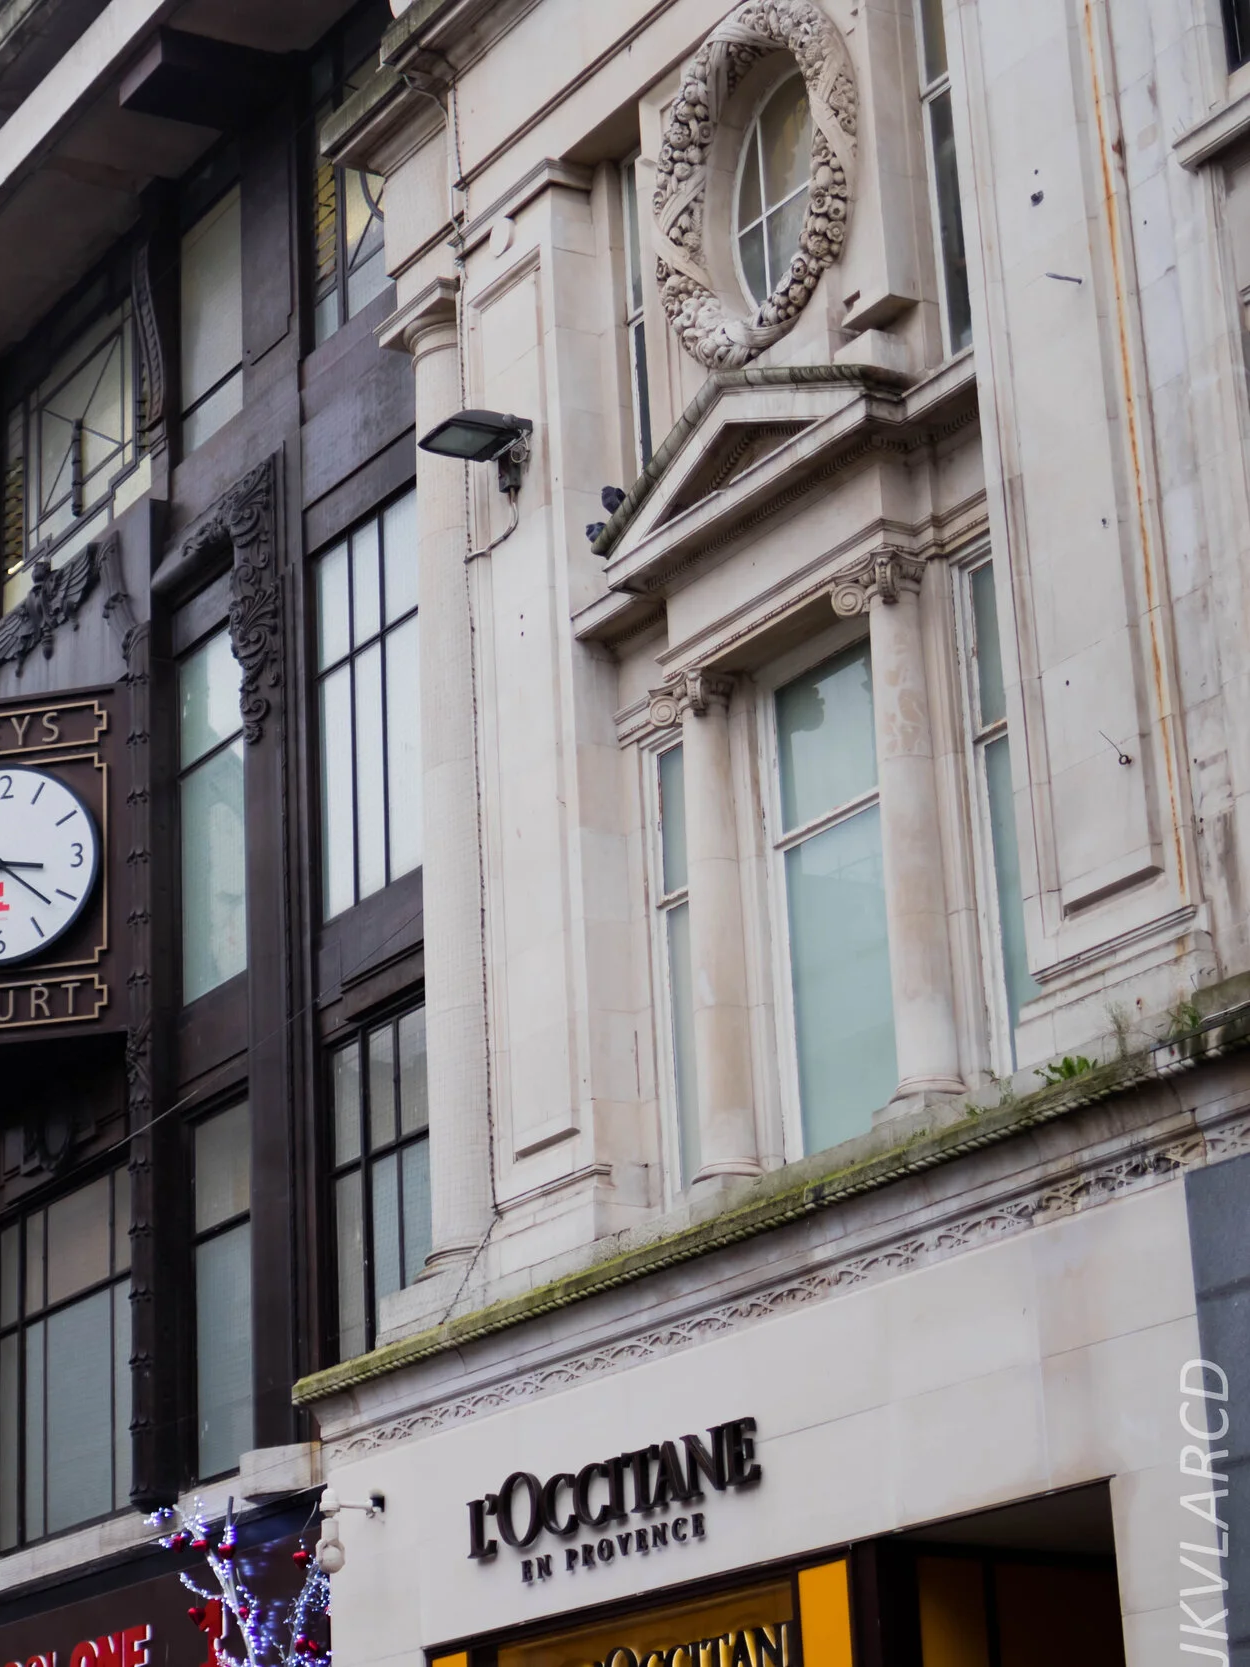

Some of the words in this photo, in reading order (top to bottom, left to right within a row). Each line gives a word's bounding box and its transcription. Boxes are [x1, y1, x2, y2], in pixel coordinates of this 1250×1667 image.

[69, 842, 85, 868] 3
[466, 1416, 762, 1559] L'OCCITANE
[520, 1554, 553, 1583] EN
[564, 1512, 706, 1571] PROVENCE
